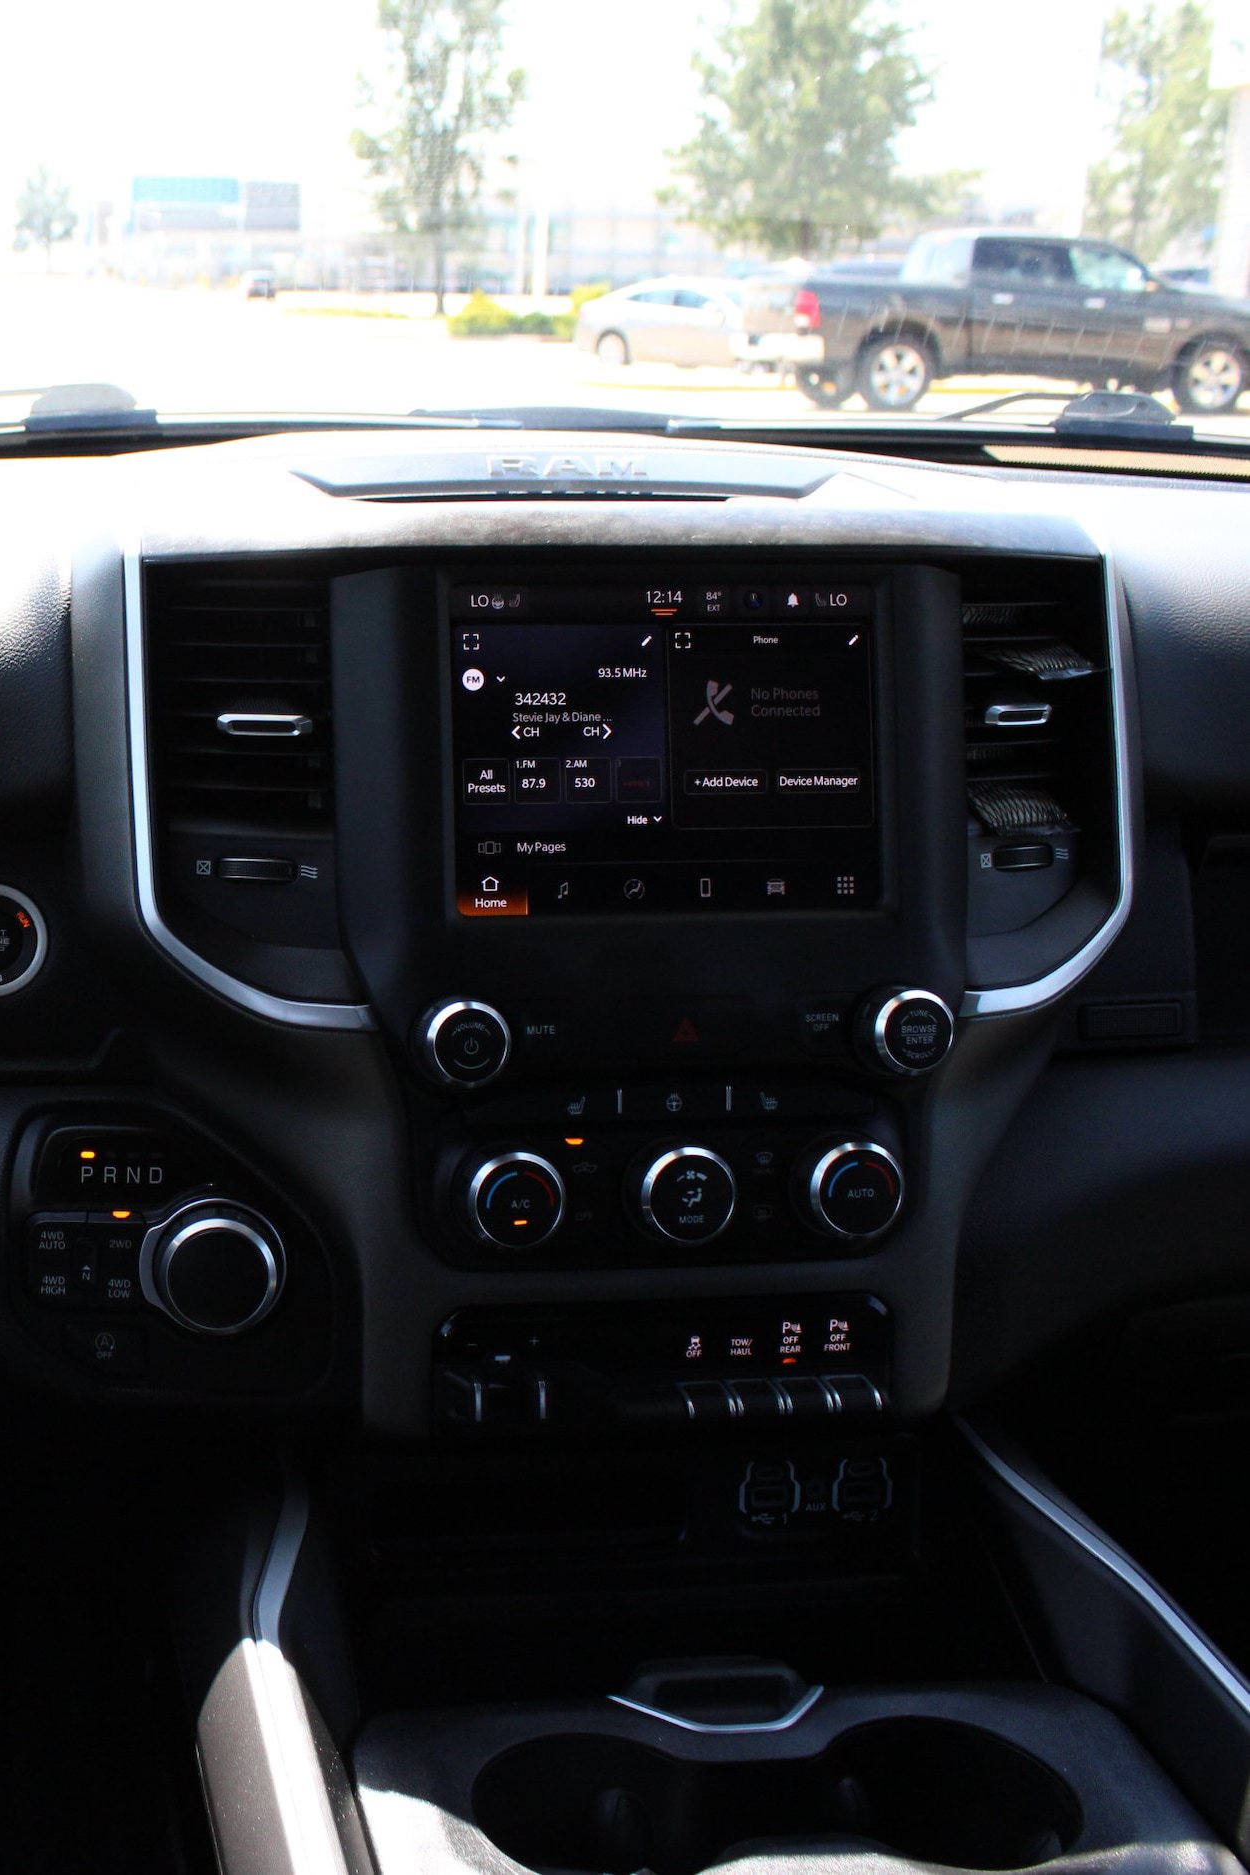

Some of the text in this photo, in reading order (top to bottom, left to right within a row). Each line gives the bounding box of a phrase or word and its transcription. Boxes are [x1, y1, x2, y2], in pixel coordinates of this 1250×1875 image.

[486, 453, 648, 478] RAM
[470, 594, 489, 607] LO
[646, 590, 683, 604] 12:14
[830, 594, 848, 607] LO
[707, 604, 721, 612] EXT
[753, 635, 779, 644] Phone
[598, 667, 647, 678] 93.5 MHz
[466, 676, 481, 684] FM
[514, 692, 567, 706] 342432
[751, 688, 819, 701] No Phones
[751, 704, 821, 717] Connected
[512, 712, 544, 723] Stevie
[545, 712, 560, 725] Jay
[562, 712, 570, 723] &
[572, 712, 601, 723] Diane
[523, 727, 540, 737] CH
[583, 726, 600, 737] CH
[480, 769, 494, 780] All
[521, 778, 546, 789] 87.9
[574, 777, 596, 788] 530
[725, 776, 759, 787] Device
[779, 776, 858, 788] Device Manager
[467, 783, 506, 794] Presets
[627, 816, 648, 825] Hide
[516, 842, 566, 854] My Pages
[475, 898, 507, 908] Home
[805, 1012, 840, 1023] SCREEN
[526, 1025, 556, 1036] MUTE
[813, 1023, 830, 1032] OFF
[901, 1024, 937, 1034] BROWSE
[906, 1035, 935, 1046] ENTER
[80, 1166, 163, 1184] P R N D
[847, 1188, 874, 1199] AUTO
[510, 1199, 530, 1209] A/C
[679, 1214, 704, 1224] MODE
[41, 1230, 64, 1240] 4WD
[38, 1240, 66, 1251] AUTO
[109, 1239, 132, 1248] 2WD
[42, 1275, 66, 1285] 4WD
[107, 1279, 131, 1289] 4WD
[41, 1286, 66, 1296] HIGH
[108, 1289, 131, 1299] LOW
[730, 1337, 753, 1346] TOW/
[783, 1335, 799, 1344] OFF
[830, 1333, 846, 1342] OFF
[730, 1347, 752, 1356] HAUL
[780, 1345, 801, 1354] REAR
[824, 1342, 852, 1352] FRONT
[96, 1351, 113, 1360] OFF
[686, 1349, 702, 1358] OFF
[805, 1502, 826, 1512] AUX
